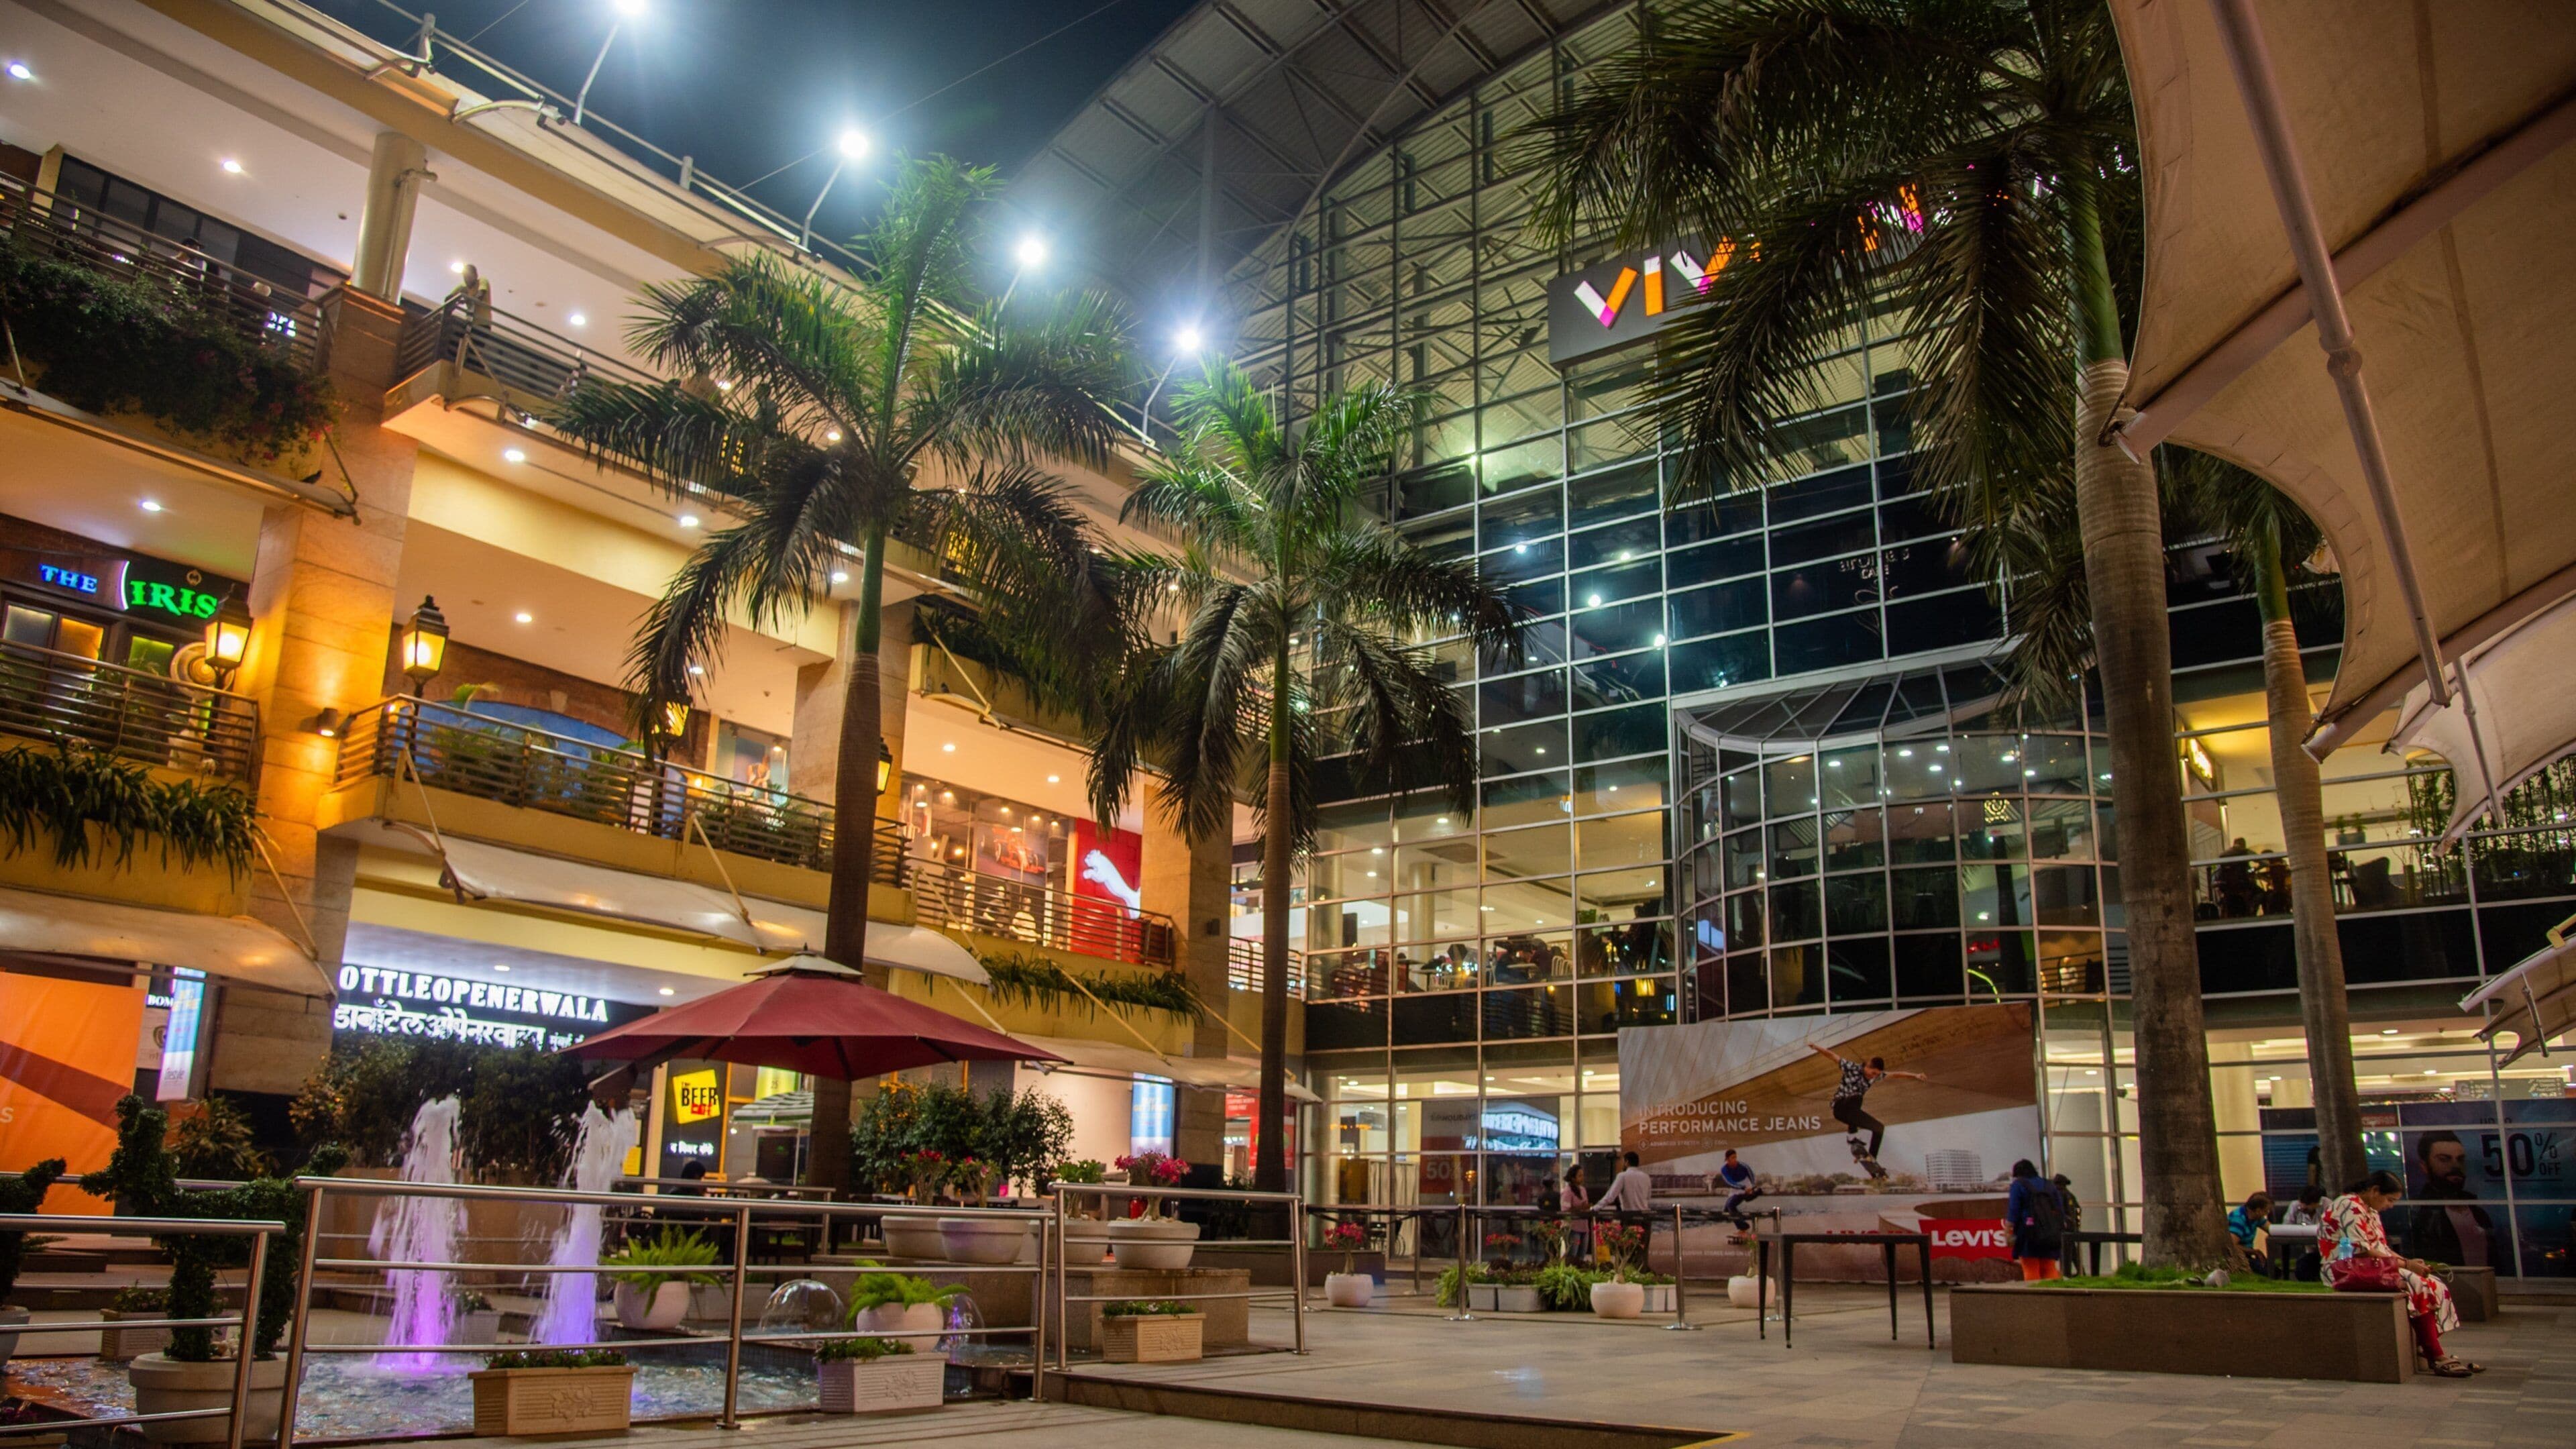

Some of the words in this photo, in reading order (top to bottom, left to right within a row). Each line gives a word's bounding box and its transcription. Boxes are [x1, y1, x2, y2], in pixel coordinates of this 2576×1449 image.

[39, 563, 98, 594] THE
[130, 580, 218, 619] IRIS
[681, 1086, 718, 1107] BEER
[1640, 1099, 1748, 1118] INTRODUCING
[1639, 1117, 1760, 1135] PERFORMANCE
[1764, 1115, 1821, 1132] JEANS
[2538, 1162, 2561, 1175] OFF
